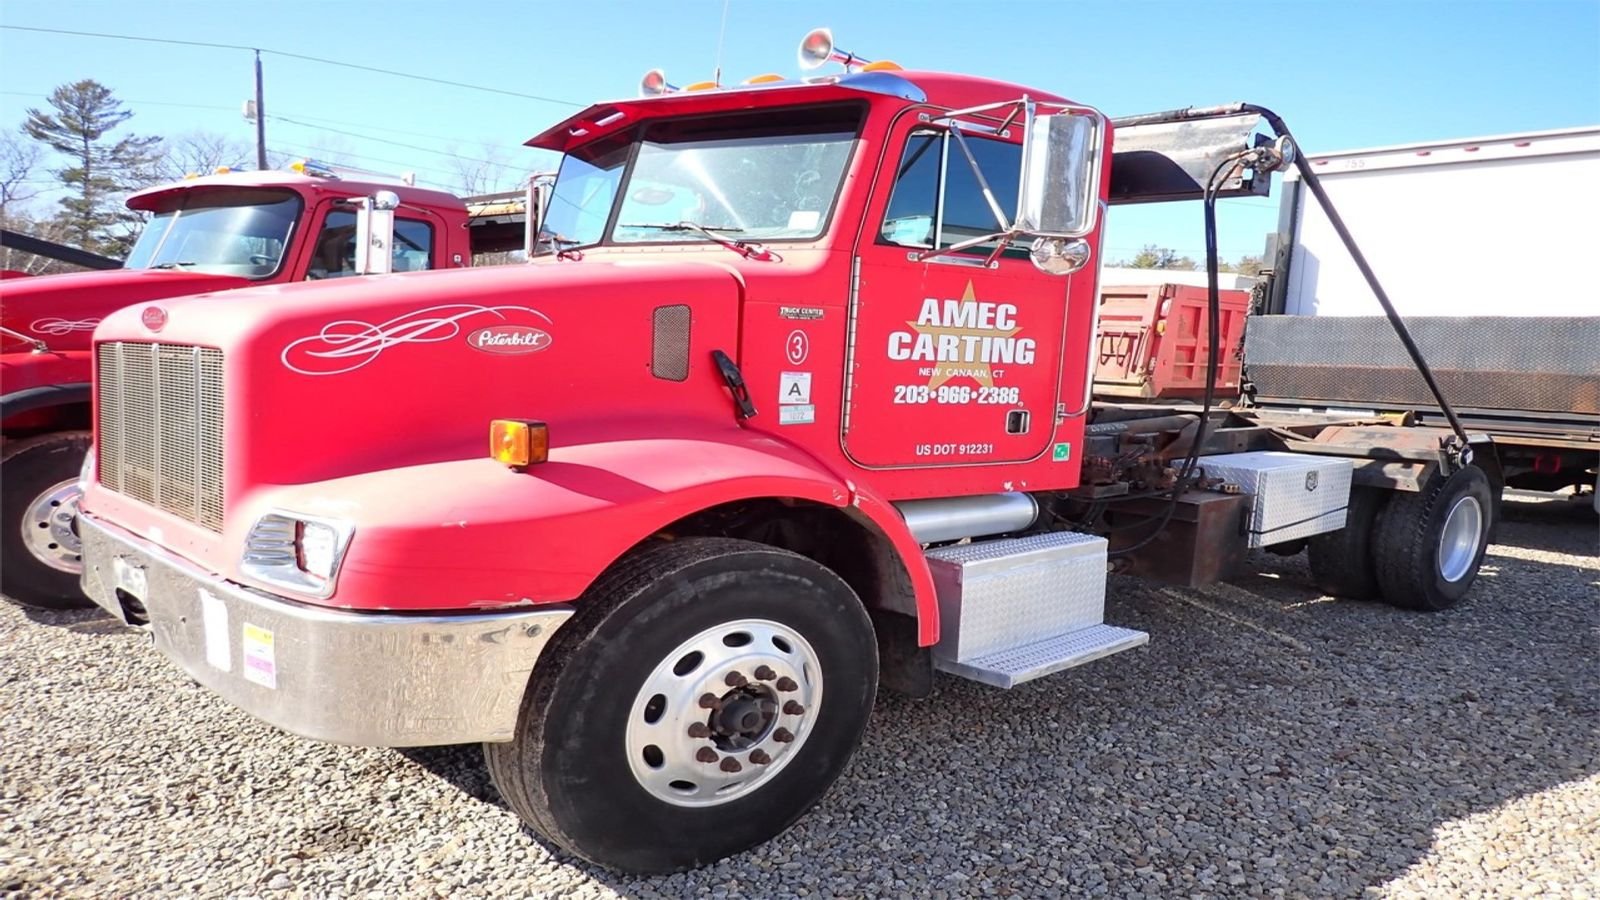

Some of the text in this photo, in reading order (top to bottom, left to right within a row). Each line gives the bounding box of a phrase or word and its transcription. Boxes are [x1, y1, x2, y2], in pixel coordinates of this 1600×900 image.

[917, 298, 1017, 329] AMEC
[478, 330, 545, 347] Peterbilt
[792, 336, 803, 359] 3
[887, 331, 1036, 365] CARTING
[919, 367, 941, 377] NEW
[993, 370, 1004, 378] CT
[788, 382, 802, 396] A
[916, 444, 994, 456] US DOT 912231
